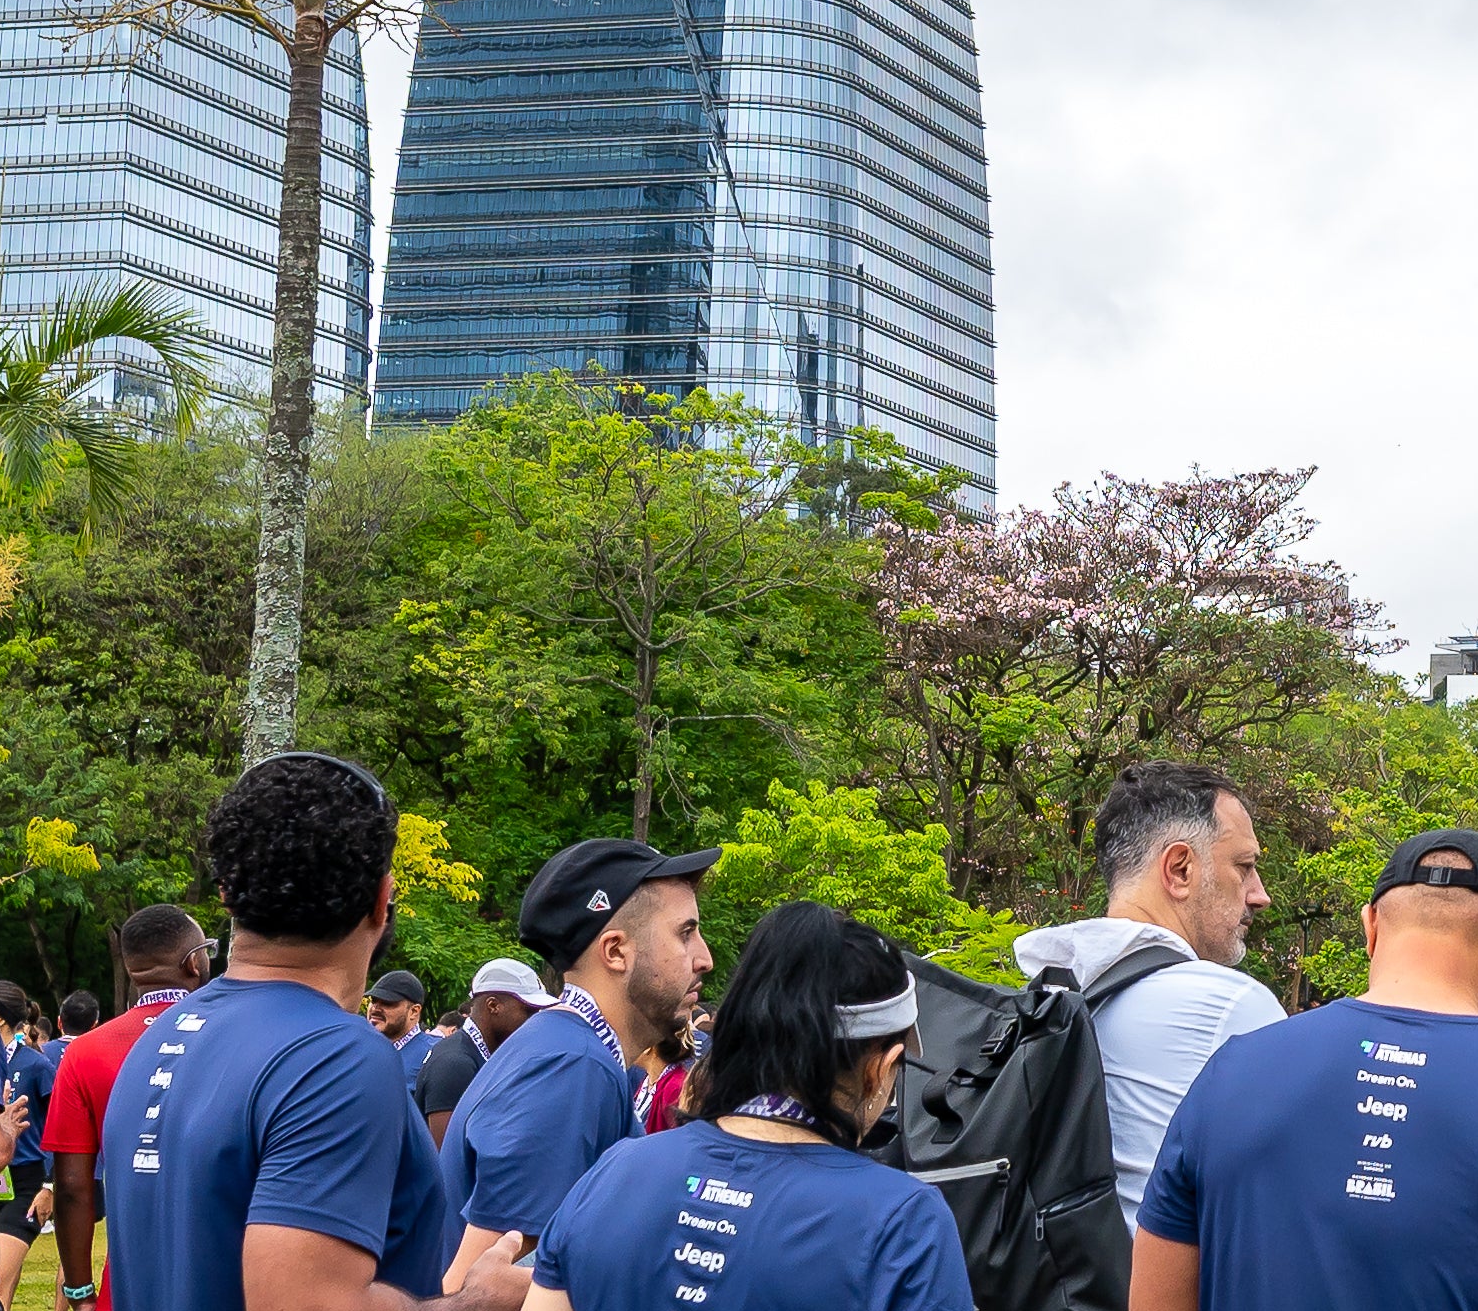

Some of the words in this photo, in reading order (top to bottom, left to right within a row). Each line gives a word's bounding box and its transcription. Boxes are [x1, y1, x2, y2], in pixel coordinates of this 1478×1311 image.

[1357, 1070, 1395, 1086] Dream
[1357, 1095, 1407, 1121] Jeep
[1362, 1133, 1393, 1149] rvb
[700, 1185, 754, 1208] ATHENAS
[678, 1210, 717, 1231] Dream
[674, 1242, 725, 1272] Jeep
[675, 1285, 707, 1303] rvb
